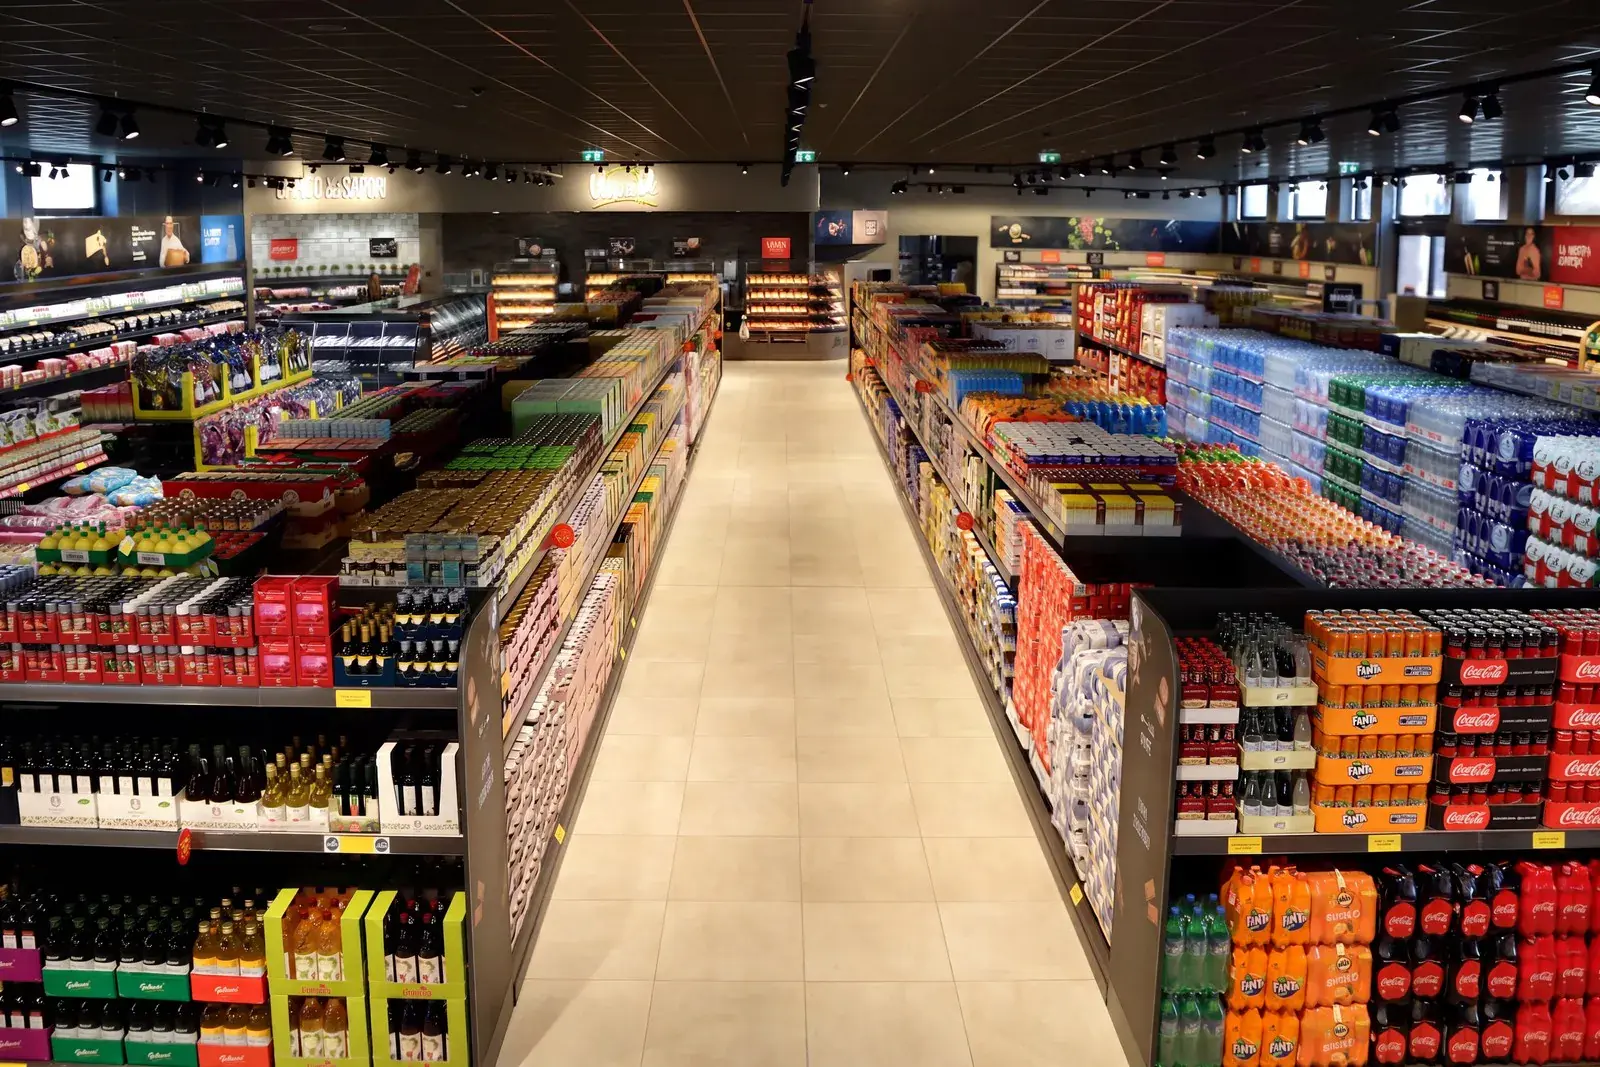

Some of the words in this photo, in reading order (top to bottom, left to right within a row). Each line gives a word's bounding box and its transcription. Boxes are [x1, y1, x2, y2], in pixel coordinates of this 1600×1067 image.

[1357, 664, 1382, 677] FANTA
[1352, 714, 1378, 727] FANTA
[1348, 764, 1373, 777] FANTA
[1342, 813, 1367, 825] FANTA
